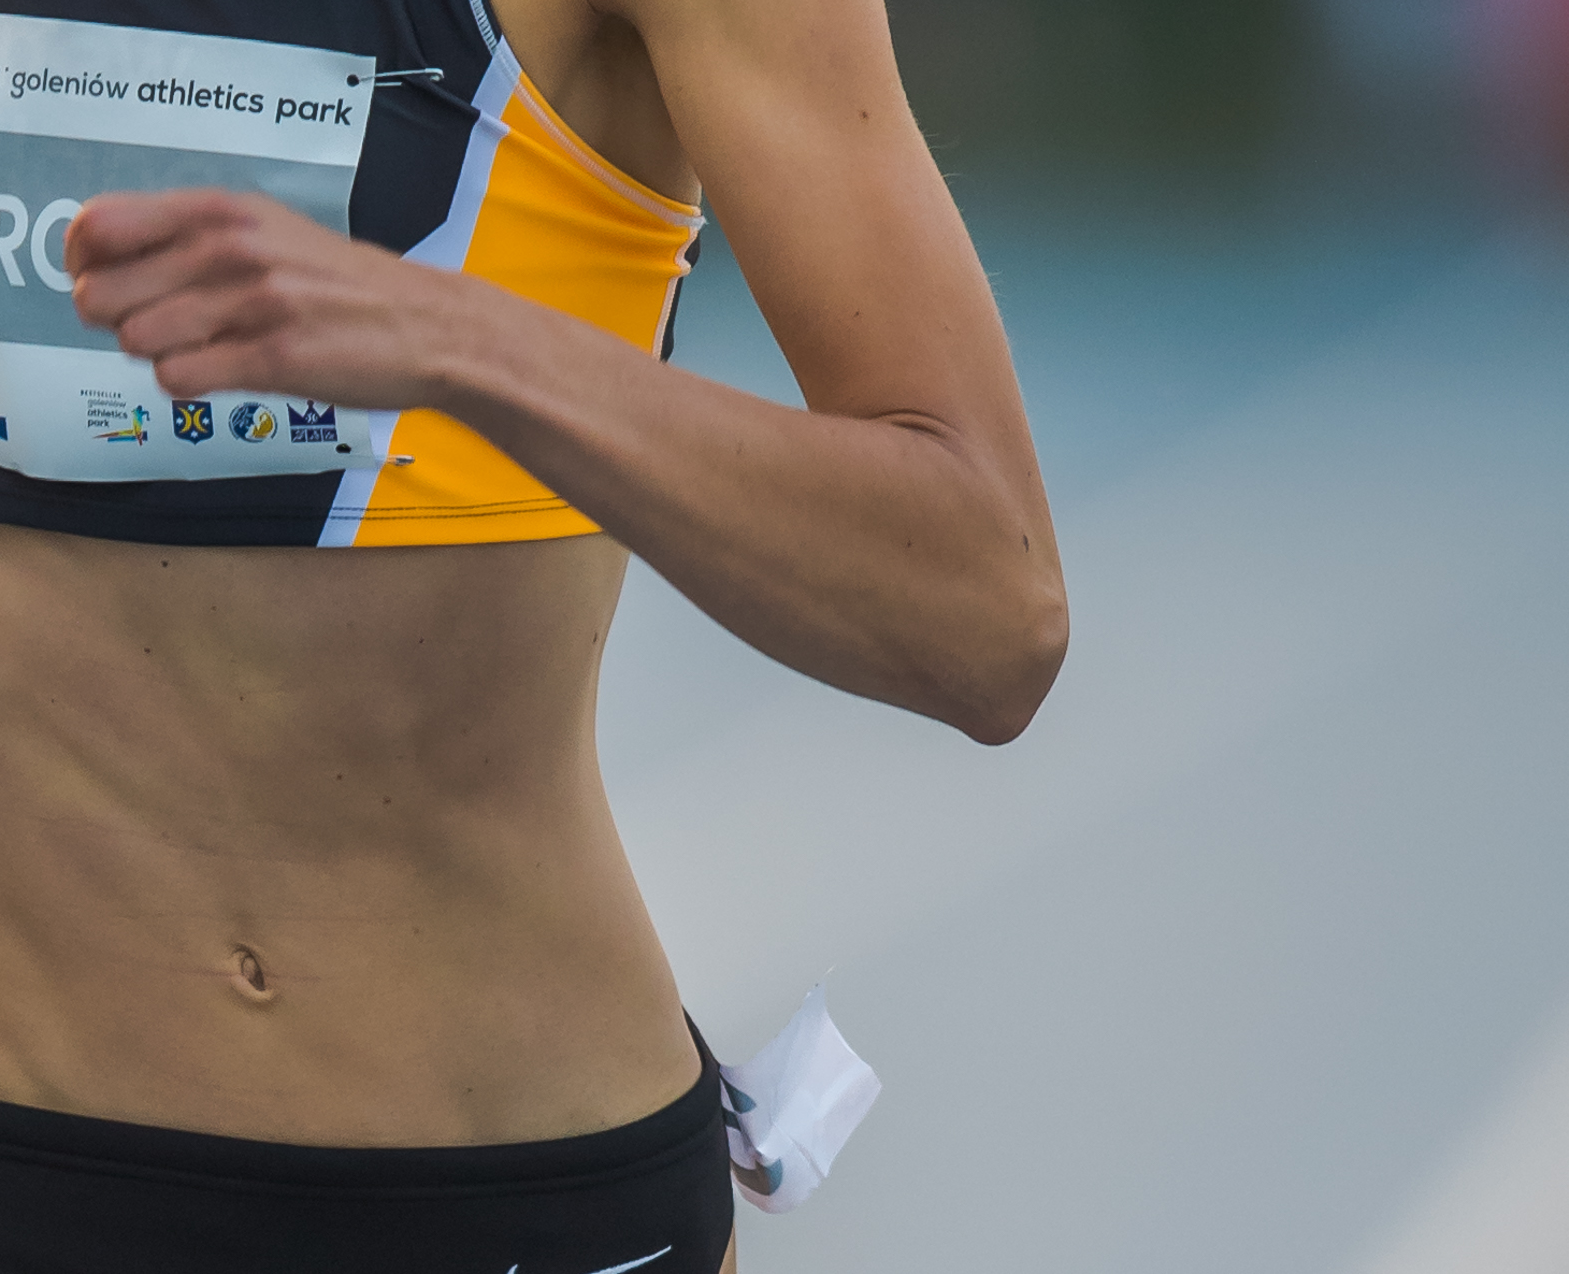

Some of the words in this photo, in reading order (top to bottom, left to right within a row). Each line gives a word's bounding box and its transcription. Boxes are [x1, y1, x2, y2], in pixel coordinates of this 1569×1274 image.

[10, 68, 130, 99] goleniów
[137, 77, 264, 113] athletics
[274, 97, 353, 126] park
[87, 418, 110, 428] park
